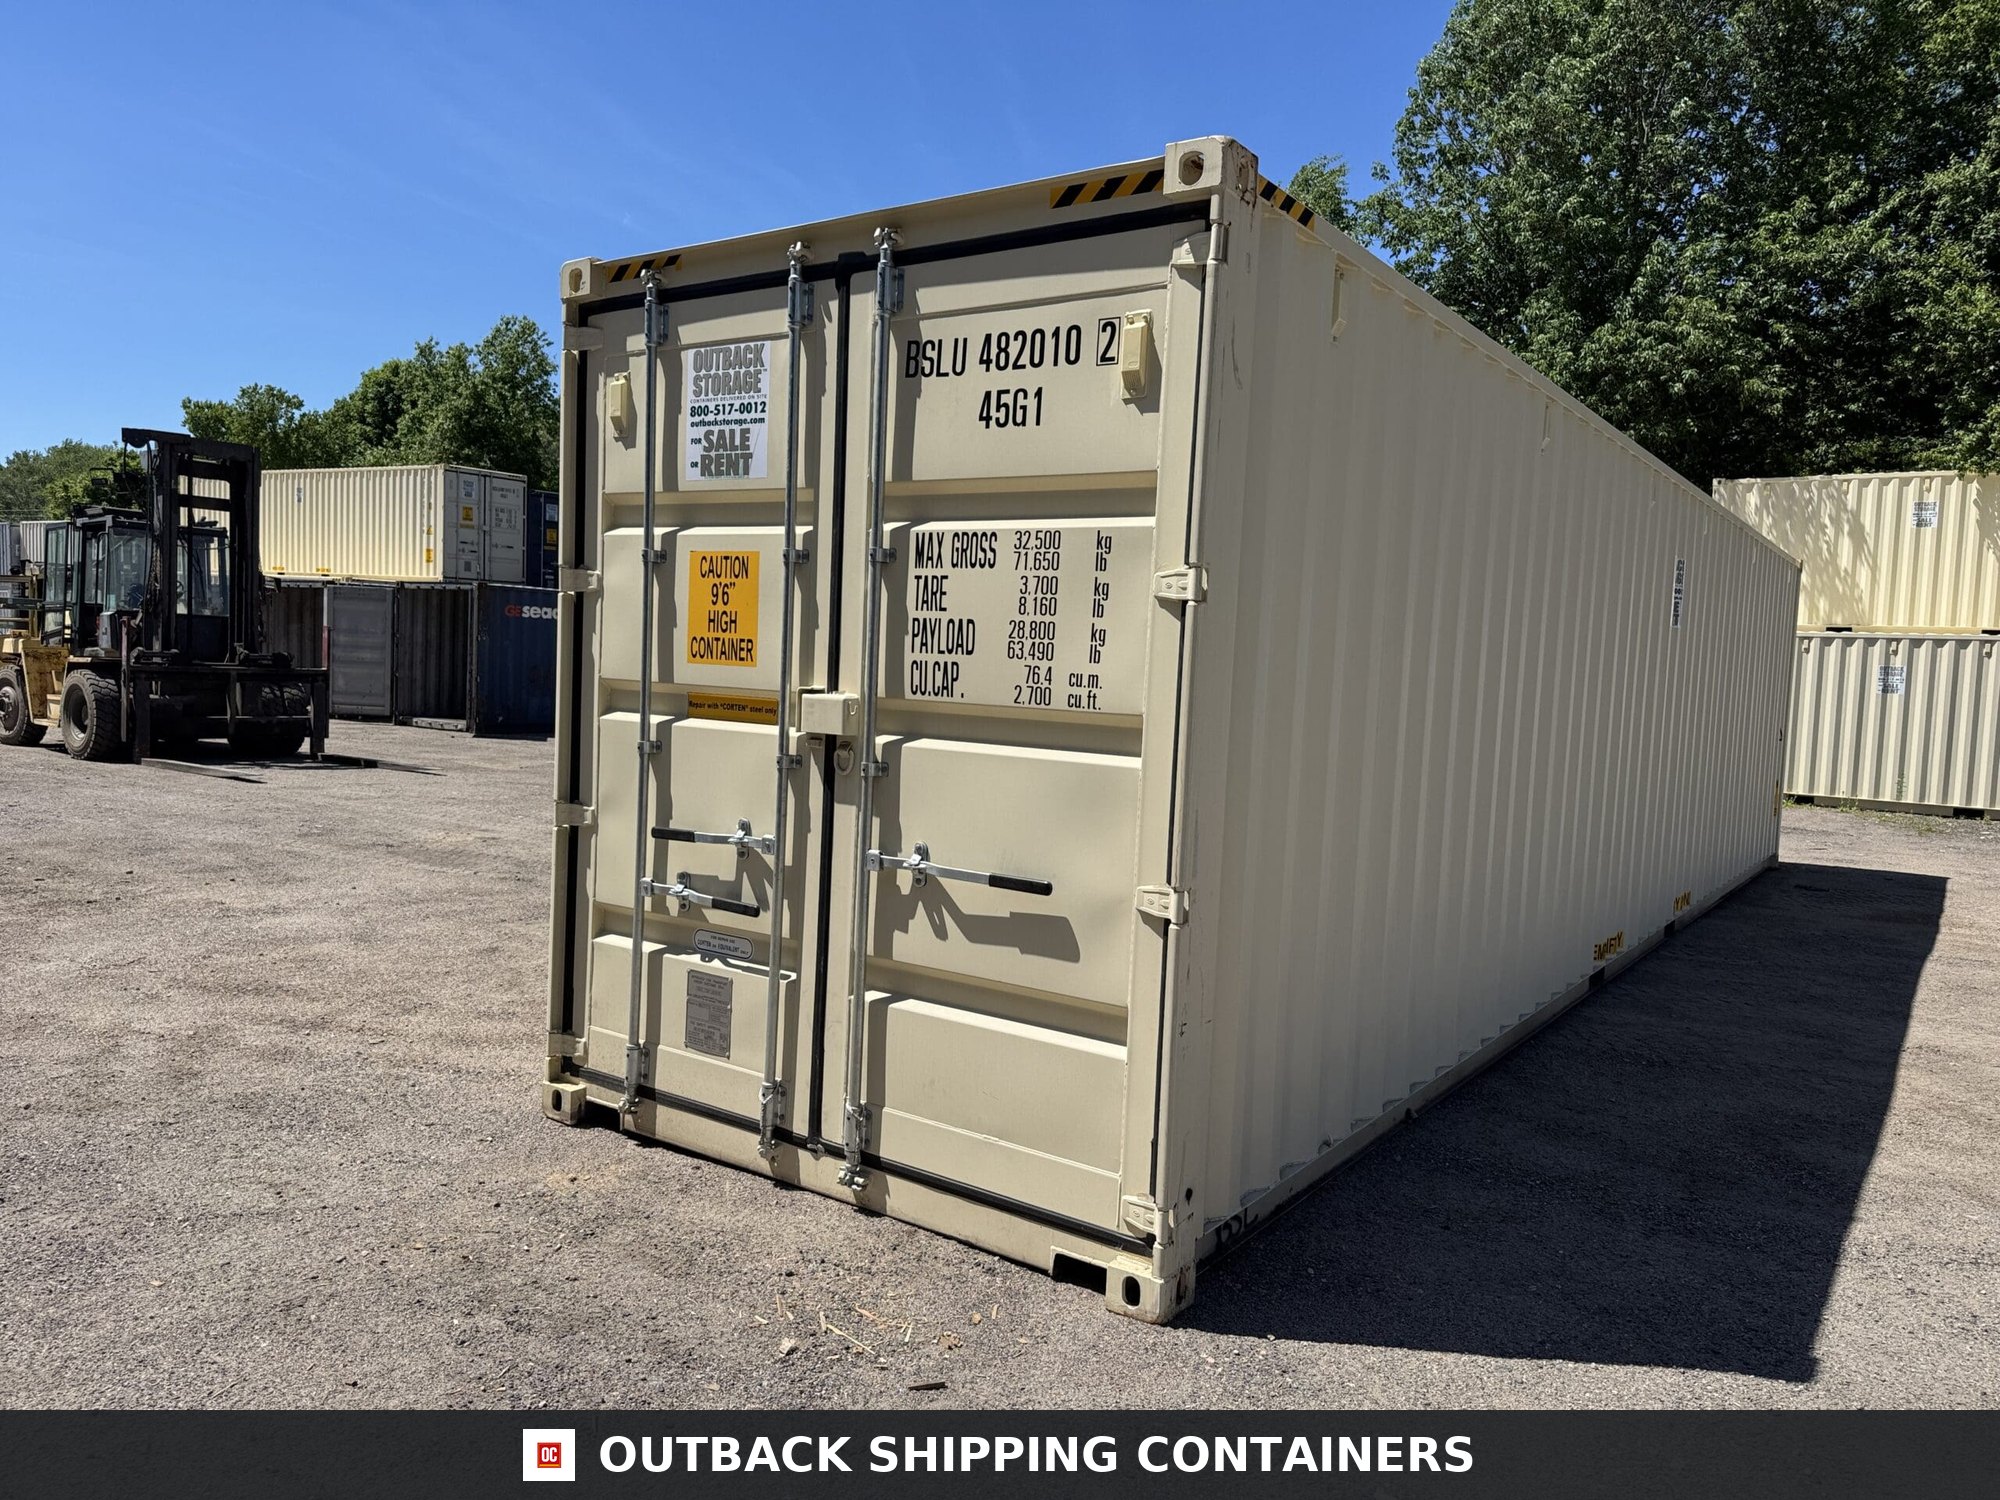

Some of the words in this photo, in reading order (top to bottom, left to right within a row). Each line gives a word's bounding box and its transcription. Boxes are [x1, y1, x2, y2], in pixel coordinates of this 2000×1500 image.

[692, 343, 766, 374] OUTBACK
[905, 337, 968, 378] BSLU
[978, 324, 1082, 372] 482010
[1098, 320, 1118, 364] 2
[692, 368, 762, 398] STORAGE
[690, 401, 767, 418] 800-517-0012
[978, 386, 1043, 429] 45G1
[690, 417, 766, 428] outbackstorage.com
[703, 428, 751, 453] SALE
[700, 453, 753, 477] RENT
[914, 531, 945, 569] MAX
[951, 531, 998, 569] GROSS
[1013, 530, 1061, 551] 32,500
[1096, 530, 1112, 555] kg
[1013, 551, 1060, 571] 71,650
[1095, 552, 1107, 572] lb
[700, 555, 749, 579] CAUTION
[914, 575, 949, 612] TARE
[1019, 575, 1059, 596] 3,700
[1094, 576, 1109, 601] kg
[1018, 596, 1057, 616] 8,160
[1092, 598, 1104, 618] lb
[707, 610, 737, 634] HIGH
[911, 617, 976, 656] PAYLOAD
[1008, 620, 1056, 641] 28,800
[1090, 622, 1106, 647] kg
[690, 636, 754, 662] CONTAINER
[1007, 640, 1055, 661] 63,490
[1089, 643, 1101, 664] lb
[1024, 664, 1052, 686] 76.4
[1068, 672, 1103, 690] cu.m.
[1013, 685, 1052, 706] 2,700
[688, 700, 706, 709] Repair
[749, 705, 764, 713] steel
[764, 707, 776, 716] only
